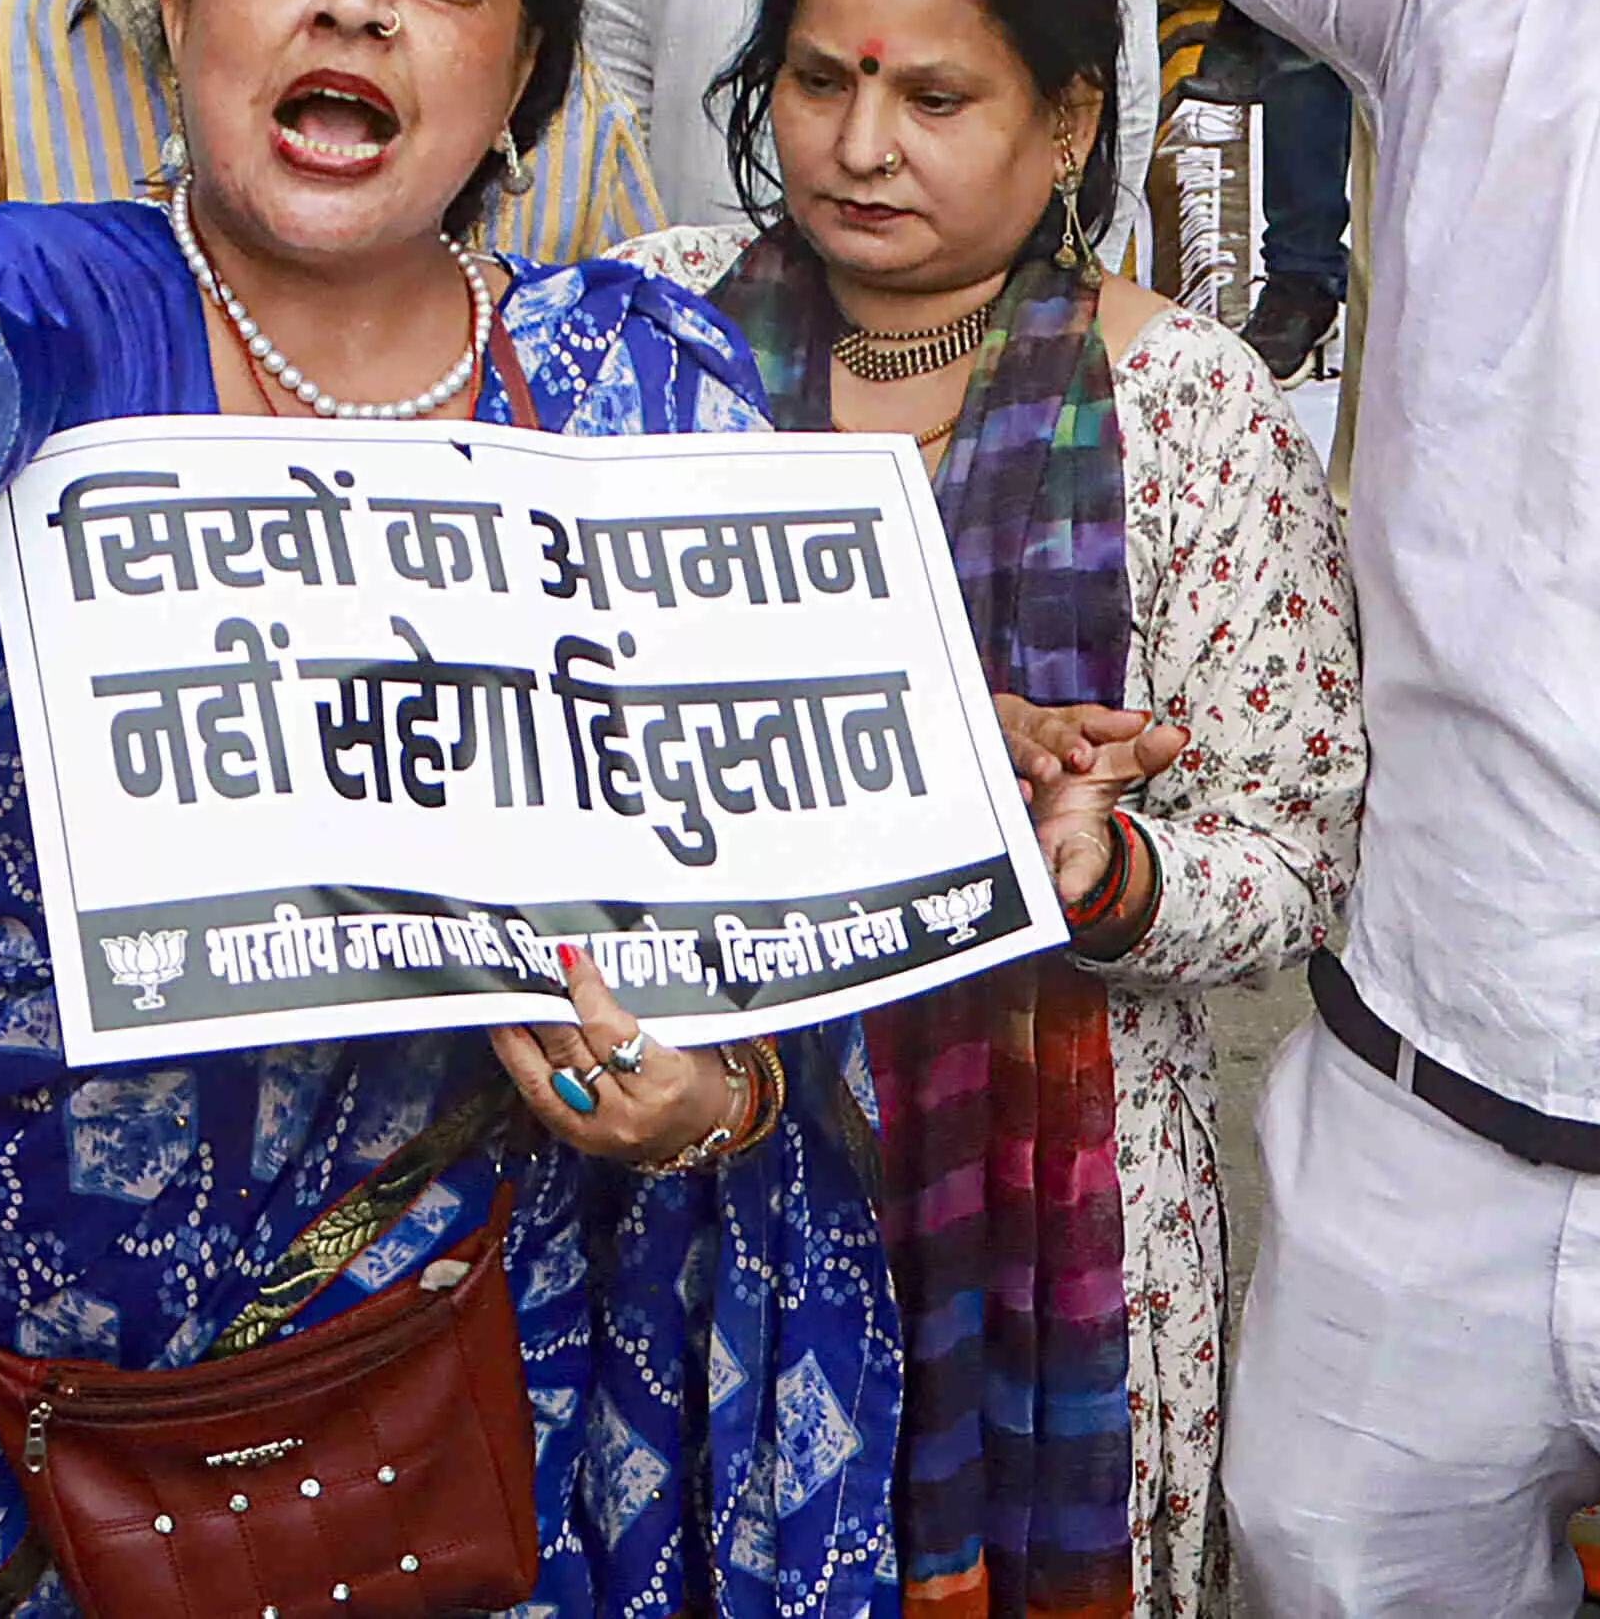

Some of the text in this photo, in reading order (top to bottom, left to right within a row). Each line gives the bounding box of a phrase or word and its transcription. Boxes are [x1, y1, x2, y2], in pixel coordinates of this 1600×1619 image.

[47, 467, 889, 610] सिखों का अपमान
[90, 617, 926, 866] नहीं सहेगा हिंदुस्तान
[205, 903, 339, 985] भारतीय
[337, 913, 443, 971] जनता
[716, 911, 820, 983] दिल्ली
[818, 901, 908, 970] प्रदेश
